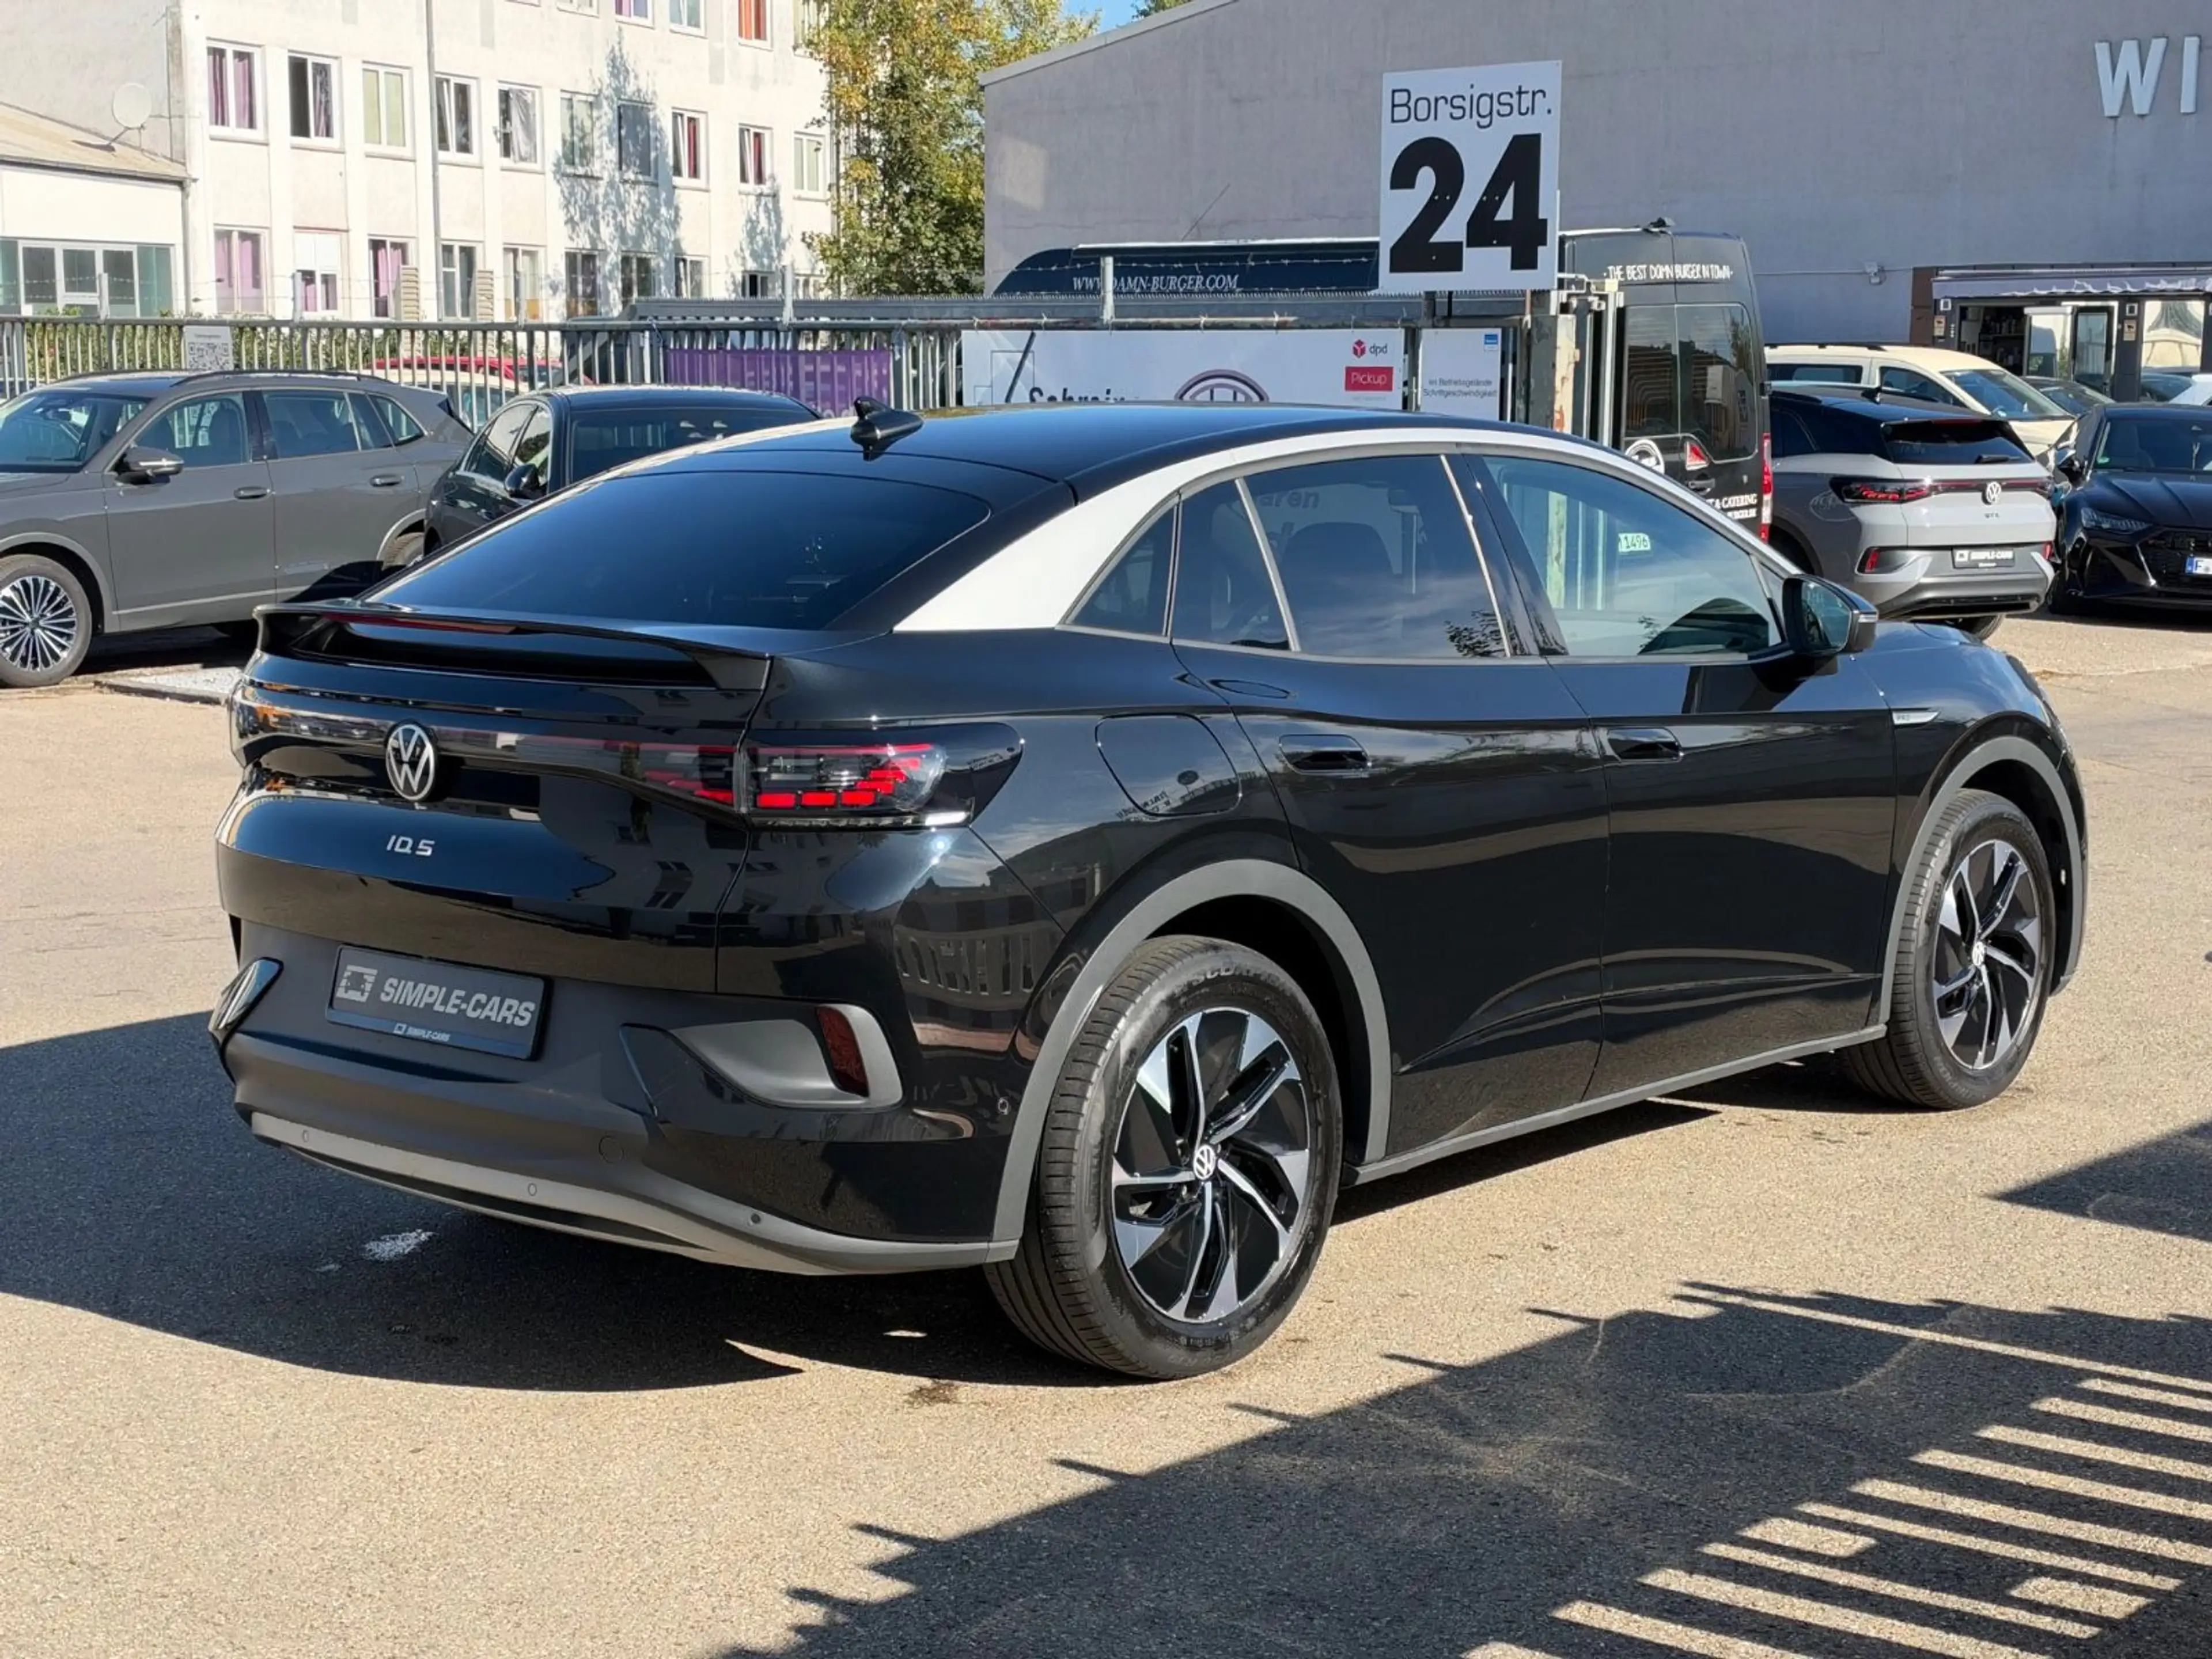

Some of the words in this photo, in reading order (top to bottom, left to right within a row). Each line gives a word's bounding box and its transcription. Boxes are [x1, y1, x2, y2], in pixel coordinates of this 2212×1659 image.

[2094, 35, 2201, 118] WI
[1391, 84, 1552, 129] Borsigstr.
[1389, 133, 1548, 274] 24
[1073, 274, 1239, 292] WWDAMN-BURGER.COM
[1626, 264, 1647, 281] BEST
[1369, 343, 1388, 357] dpd
[1351, 372, 1387, 388] Pickup
[380, 978, 536, 1027] SIMPLE-CARS
